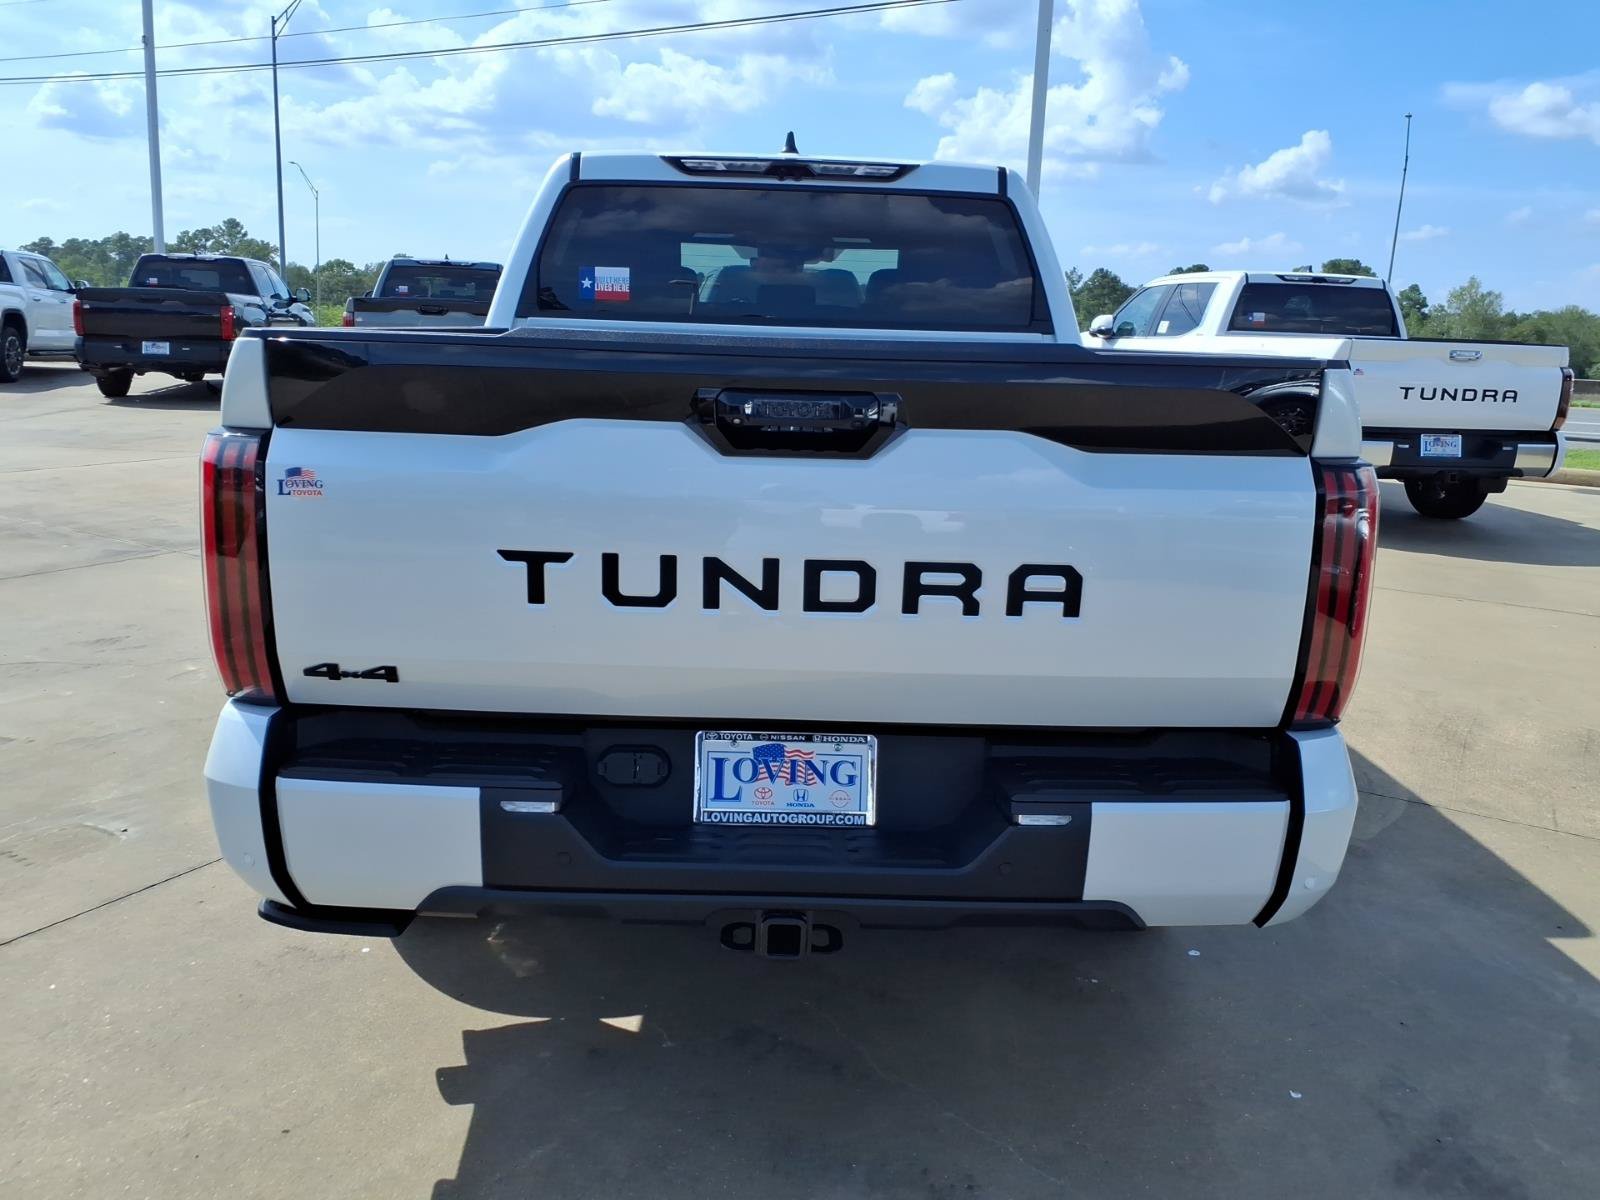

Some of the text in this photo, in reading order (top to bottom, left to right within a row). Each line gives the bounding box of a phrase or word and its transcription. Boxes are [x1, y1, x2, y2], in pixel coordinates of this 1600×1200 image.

[613, 284, 630, 292] HERE
[1399, 386, 1519, 403] TUNDRA
[277, 479, 323, 496] LOVING
[496, 549, 1084, 618] TUNDRA
[719, 732, 754, 741] TOYOTA
[823, 736, 866, 744] HONDA
[710, 756, 859, 802] LOVING
[703, 811, 866, 825] LOVINGAUTOGROUP.COM
